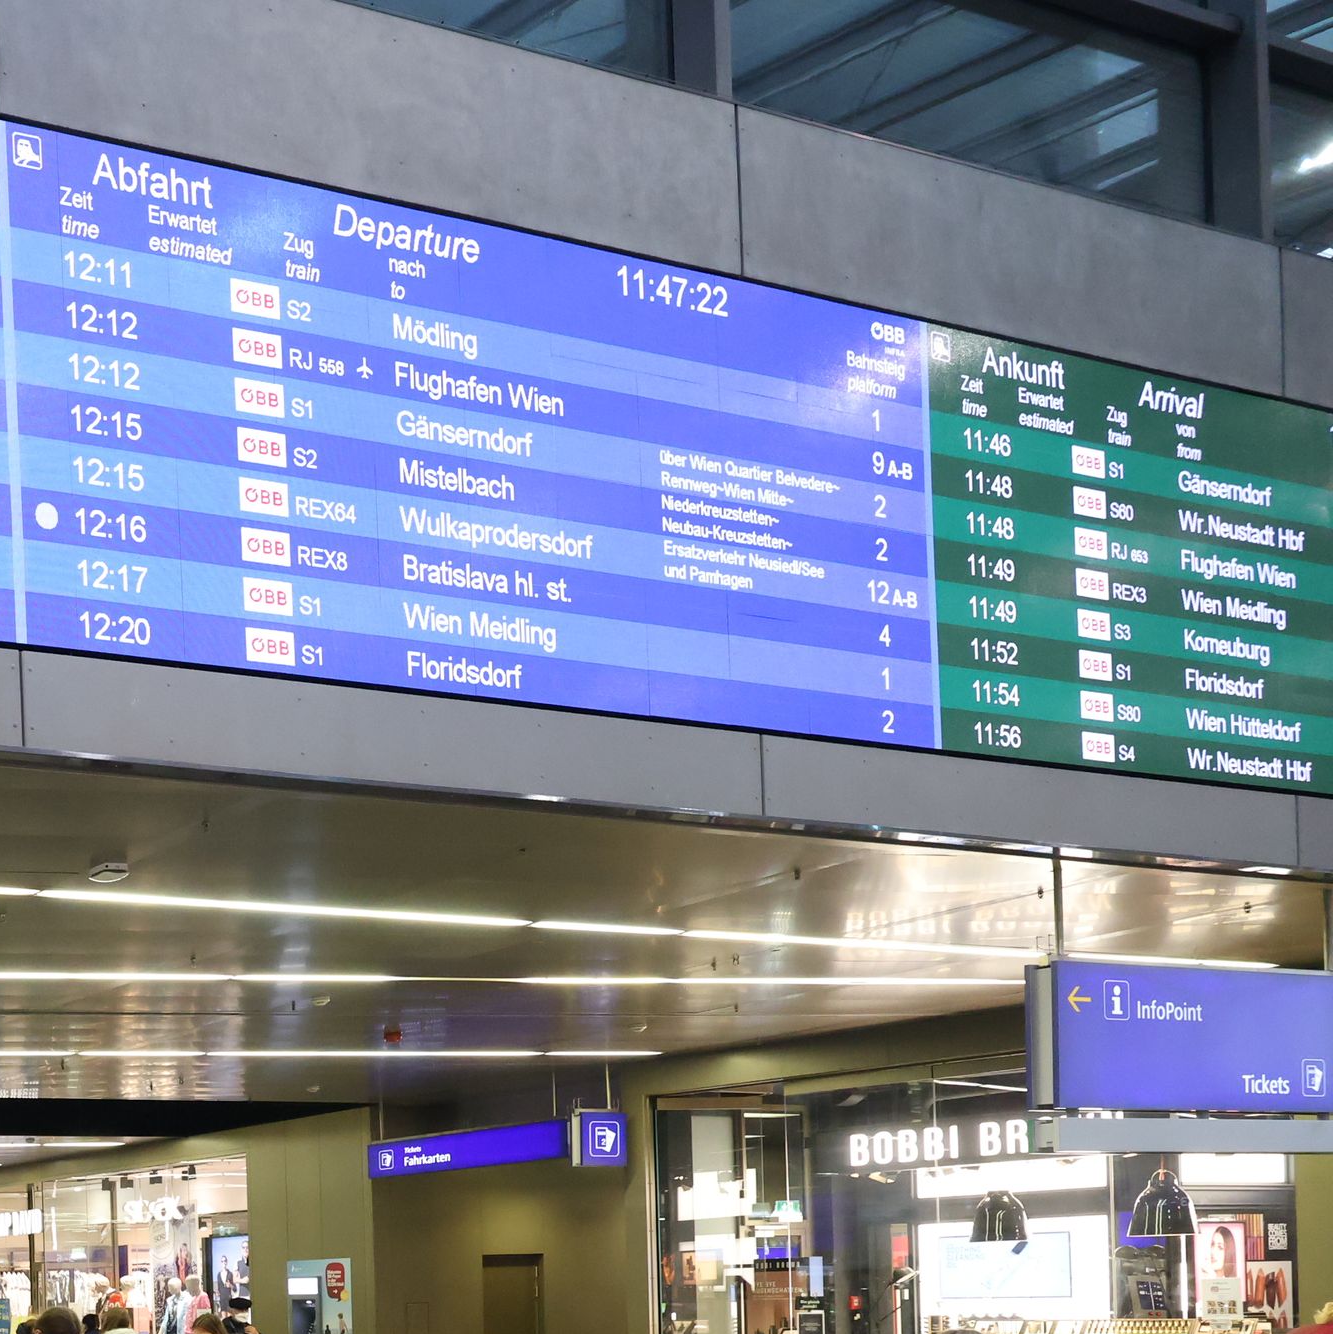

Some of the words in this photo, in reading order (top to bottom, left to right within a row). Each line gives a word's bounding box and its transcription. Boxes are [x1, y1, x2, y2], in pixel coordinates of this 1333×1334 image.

[93, 154, 213, 208] Abfahrt
[334, 204, 479, 263] Departure
[65, 251, 130, 288] 12:11
[618, 266, 728, 317] 11:47:22
[393, 313, 477, 360] Mödling
[982, 346, 1064, 389] Ankunft
[395, 362, 501, 405] Flughafen
[508, 383, 563, 416] Wien
[1139, 382, 1204, 418] Arrival
[397, 410, 532, 456] Gänserndorf
[964, 428, 1011, 456] 11:46
[400, 458, 514, 500] Mistelbach
[1178, 471, 1271, 506] Gänserndorf
[76, 508, 146, 542] 12:16
[296, 496, 356, 523] REX64
[1110, 502, 1133, 521] S60
[399, 506, 593, 559] Wulkaprodersdorf
[298, 546, 347, 570] REX8
[1181, 550, 1254, 581] Flughafen
[1257, 563, 1296, 588] Wien
[404, 554, 508, 593] Bratislava
[515, 571, 538, 597] hl.
[547, 579, 571, 602] st.
[868, 580, 890, 605] 12
[893, 590, 917, 608] A-B
[1113, 583, 1146, 603] REX3
[403, 602, 462, 634] Wien
[470, 612, 556, 652] Meidling
[1185, 629, 1270, 666] Korneuburg
[408, 651, 522, 689] Floridsdorf
[1186, 669, 1263, 699] Floridsdorf
[973, 680, 1019, 706] 11:54
[1186, 708, 1226, 733] Wien
[1231, 714, 1301, 742] Hütteldorf
[1136, 1001, 1202, 1022] InfoPoint
[1242, 1074, 1290, 1095] Tickets
[403, 1153, 451, 1167] Fahrkarten
[849, 1124, 960, 1167] BOBBI
